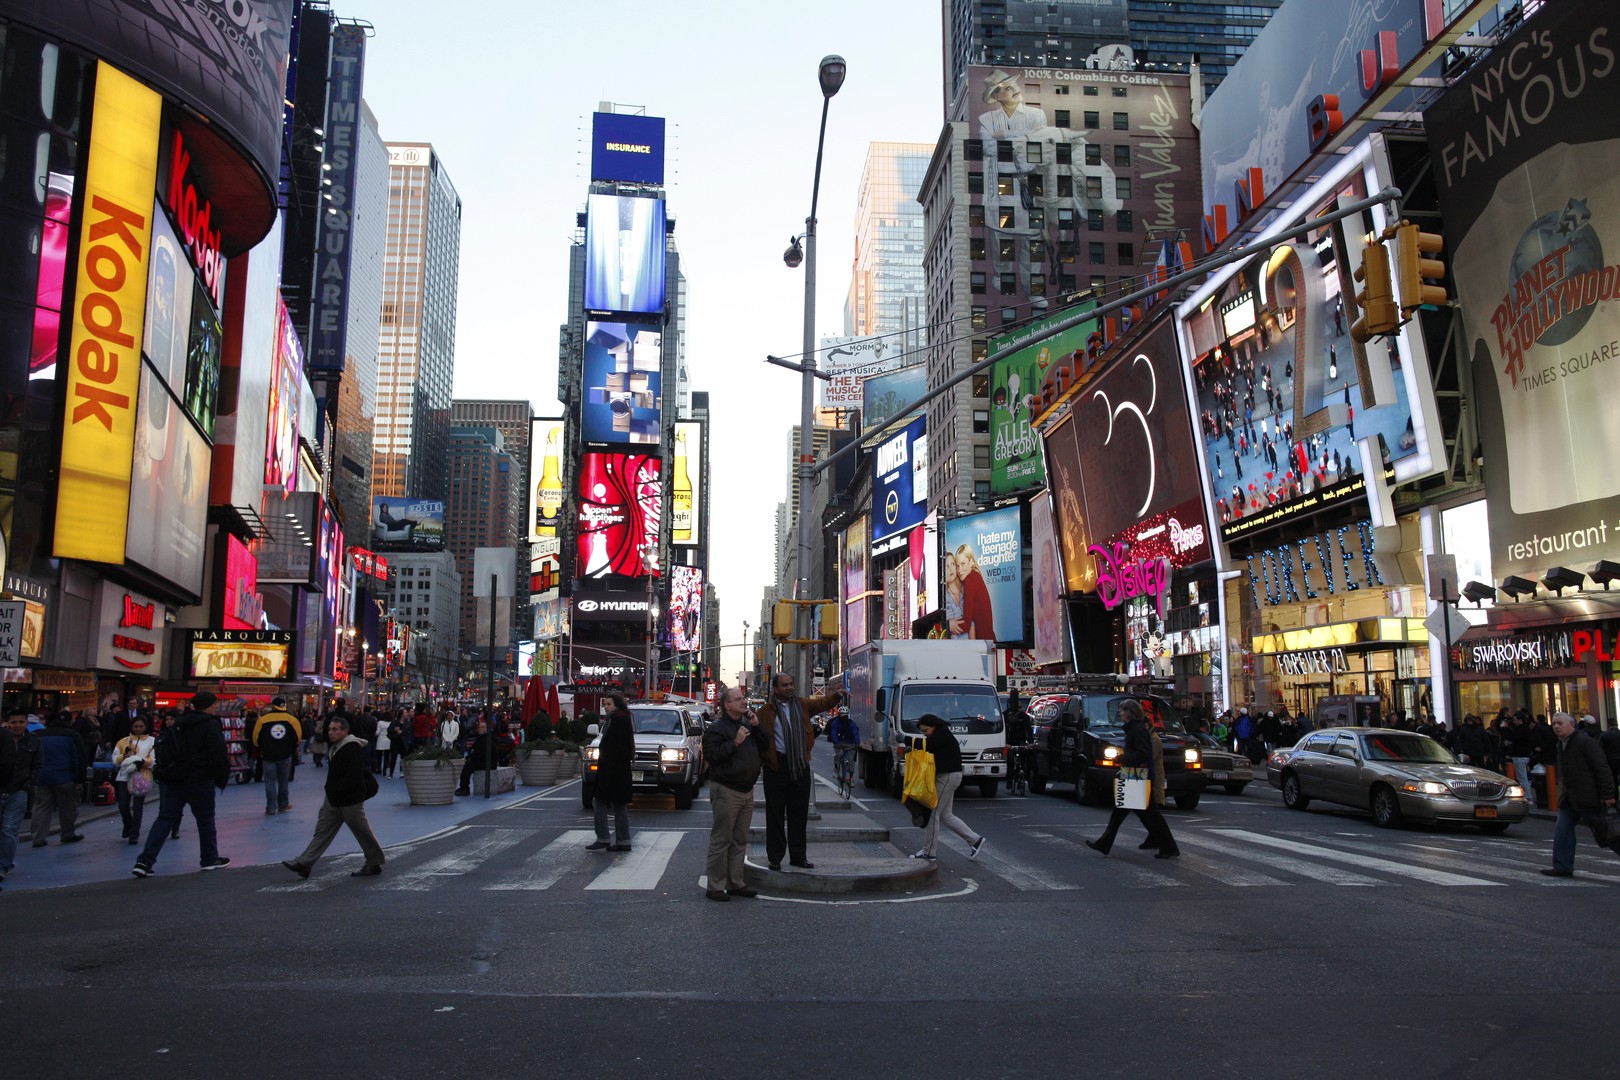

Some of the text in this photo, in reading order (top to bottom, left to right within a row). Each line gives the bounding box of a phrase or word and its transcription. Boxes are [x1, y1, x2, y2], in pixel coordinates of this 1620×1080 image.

[1024, 69, 1051, 80] 100%
[1055, 71, 1118, 83] Colombian
[1471, 30, 1554, 113] NYC'S
[1441, 27, 1615, 187] FAMOUS
[606, 142, 651, 154] INSURANCE
[322, 55, 358, 332] TIMES SQUARE
[168, 128, 224, 311] Kodak
[1490, 243, 1571, 359] PLANET
[71, 193, 146, 434] Kodak
[317, 348, 336, 356] NYC
[1522, 340, 1620, 393] TIMES SQUARE
[994, 437, 1037, 461] GREGORY
[1007, 465, 1018, 473] SUN
[532, 541, 560, 555] INGLOT
[980, 532, 1000, 545] hate
[1000, 529, 1016, 542] my
[982, 539, 1018, 555] teenage
[1508, 519, 1608, 562] restaurant
[978, 551, 1017, 567] daughter
[1246, 520, 1384, 609] FOREVER
[987, 568, 1002, 577] WED
[1087, 540, 1172, 621] Disney
[7, 576, 49, 599] ARQUIS
[600, 601, 649, 611] HYUNDAI
[193, 630, 291, 641] MARQUIS
[205, 650, 272, 675] FOLLIES
[1275, 648, 1350, 676] FOREVER 21
[1473, 641, 1542, 663] SWAROVSKI
[707, 684, 716, 699] tkts
[1116, 779, 1126, 807] MoMA
